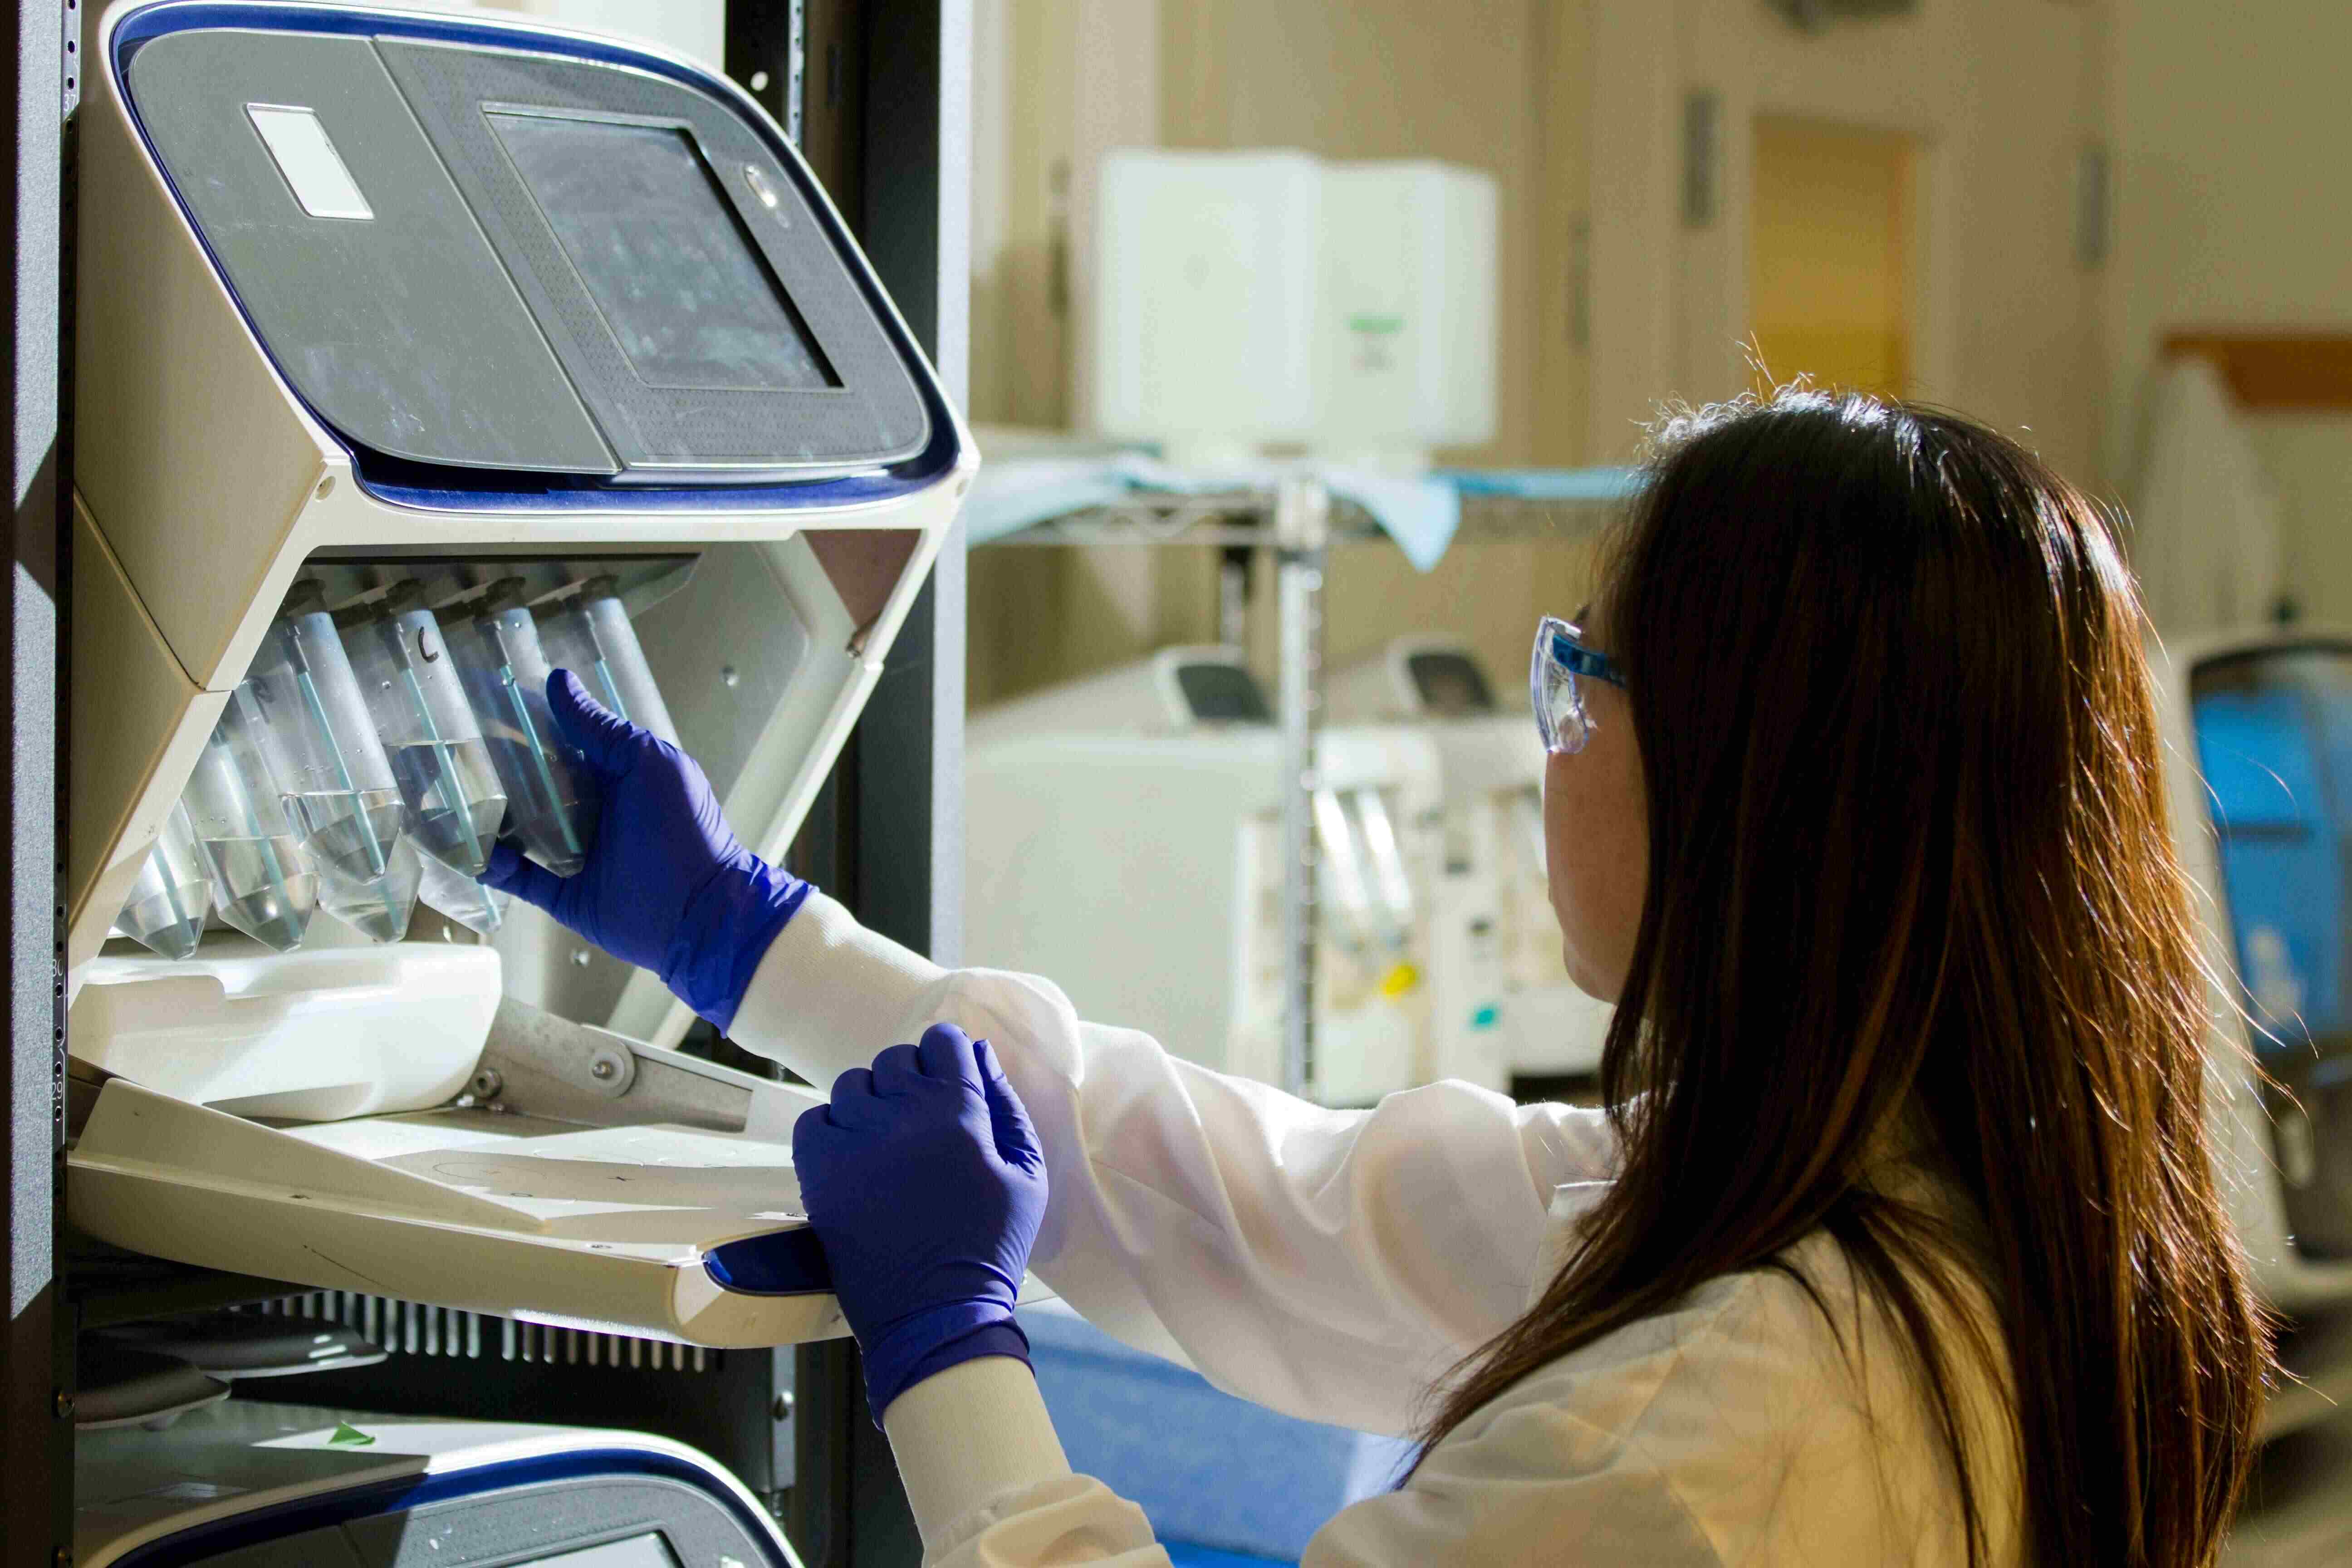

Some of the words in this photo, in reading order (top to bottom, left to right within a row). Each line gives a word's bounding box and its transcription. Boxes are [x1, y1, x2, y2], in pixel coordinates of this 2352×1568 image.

[64, 93, 76, 111] 37
[52, 958, 64, 977] 30
[51, 1081, 63, 1100] 29
